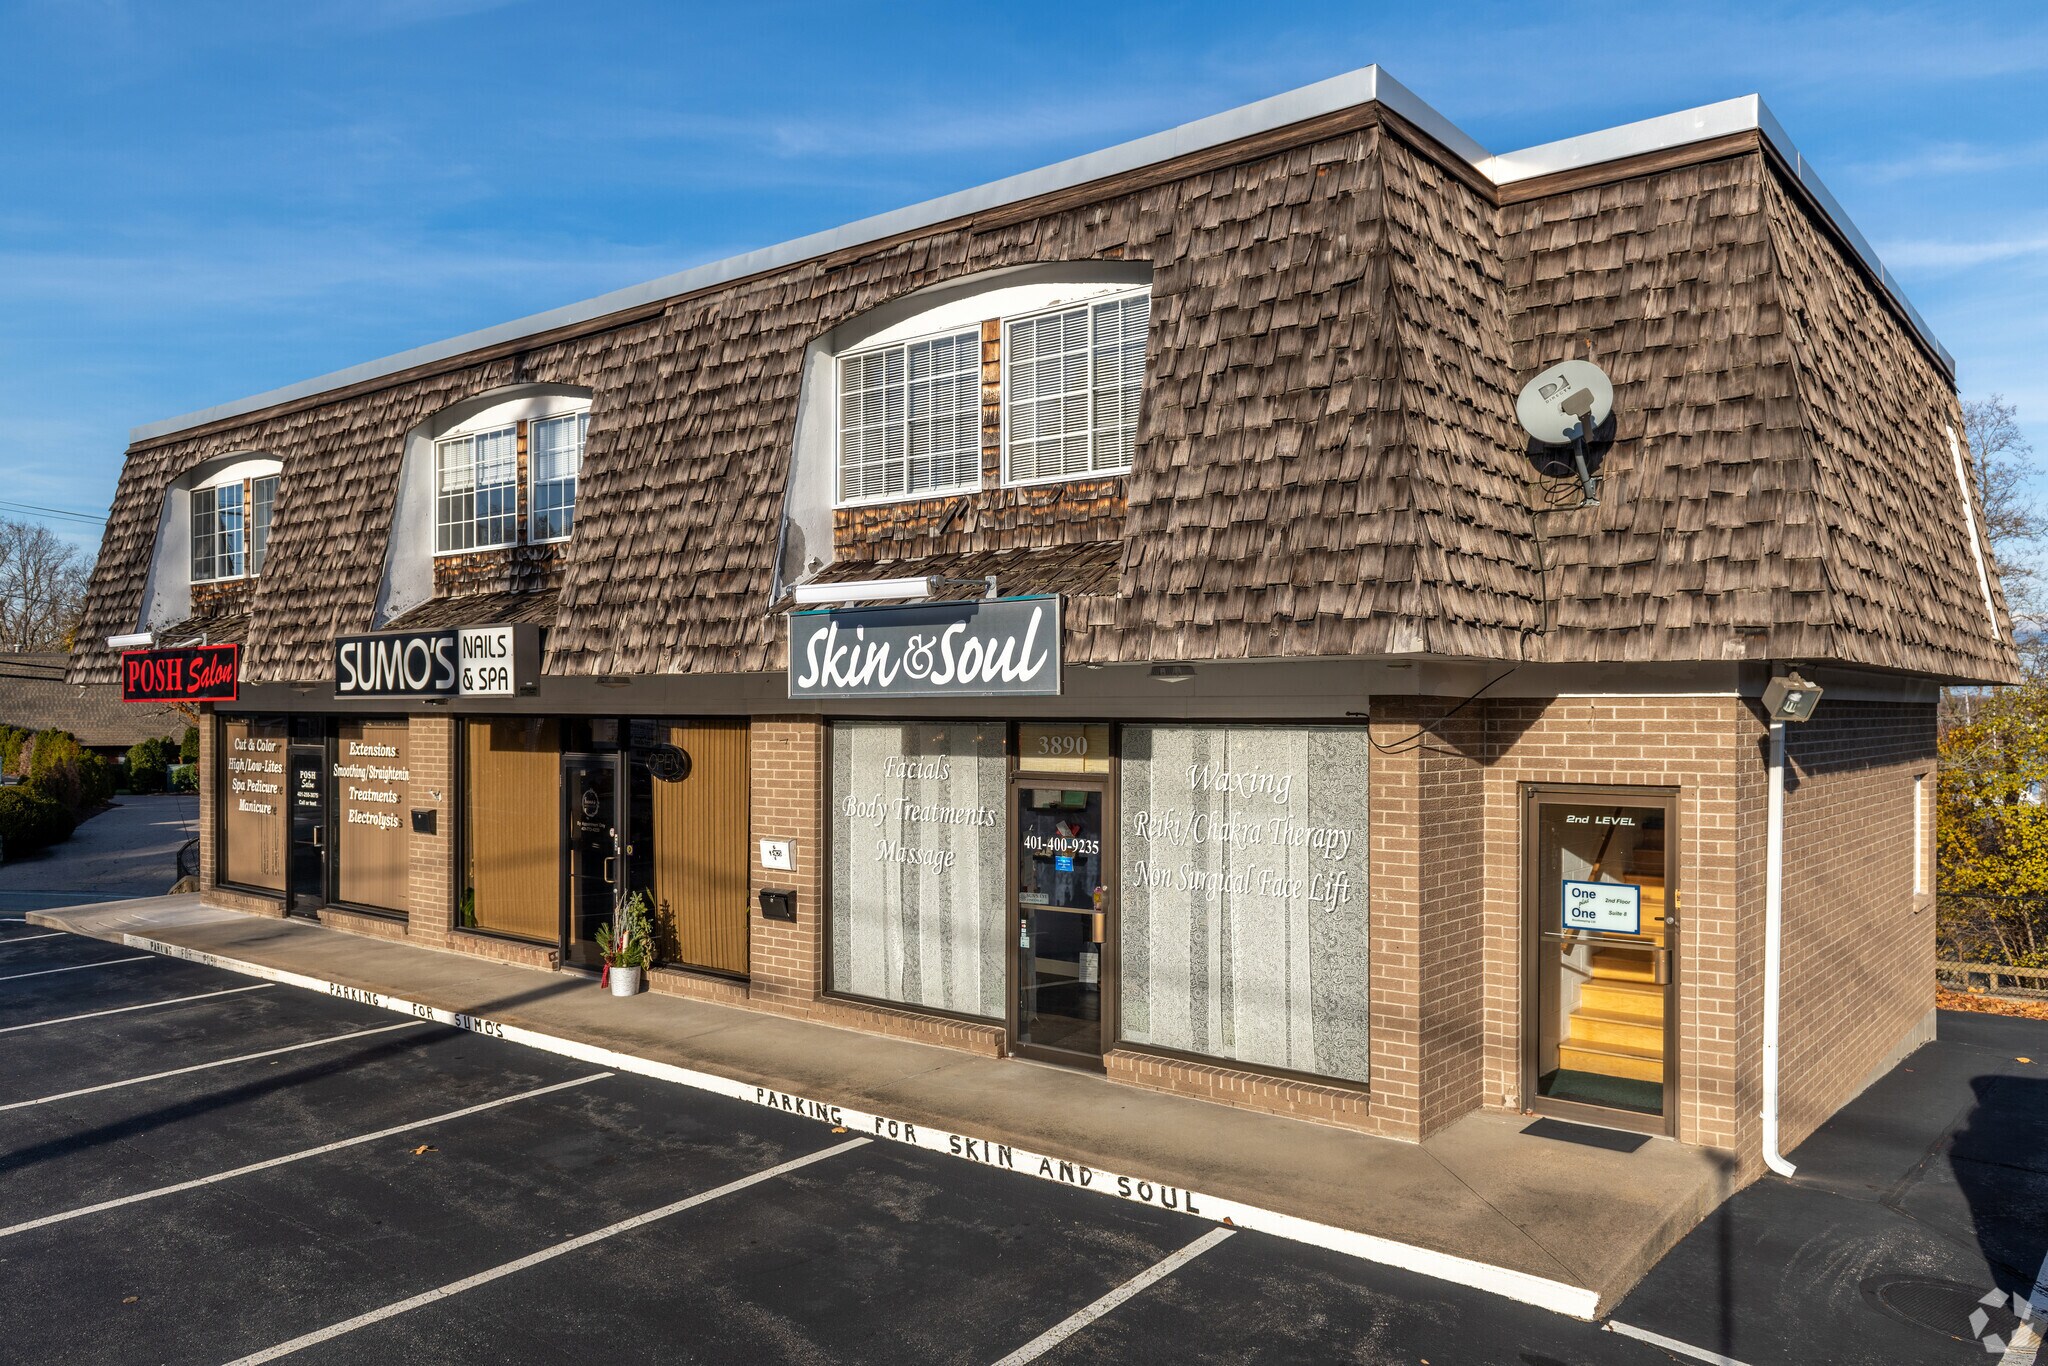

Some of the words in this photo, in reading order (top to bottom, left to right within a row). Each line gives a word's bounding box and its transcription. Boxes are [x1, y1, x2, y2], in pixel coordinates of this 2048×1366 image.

[463, 635, 506, 659] NAILS
[798, 620, 900, 688] Skin
[903, 633, 937, 680] &
[930, 606, 1048, 685] Soul
[127, 658, 183, 693] POSH
[187, 653, 233, 694] Salon
[340, 637, 456, 691] SUMO'S
[463, 668, 474, 690] &
[479, 667, 508, 691] SPA
[234, 738, 247, 751] Cut
[247, 738, 256, 751] &
[256, 738, 277, 752] Color
[349, 742, 397, 757] Extensions
[1038, 735, 1088, 756] 3890
[228, 757, 283, 774] High/Low-Lites
[649, 753, 680, 771] OPEN
[883, 754, 950, 780] Facials
[300, 770, 316, 779] POSH
[333, 763, 411, 784] Smoothing/Straightenin
[1185, 761, 1292, 805] Waxing
[232, 778, 246, 794] Spa
[247, 779, 278, 794] Pedicure
[348, 786, 398, 803] Treatments
[239, 798, 272, 814] Manicure
[842, 793, 888, 827] Body
[891, 796, 997, 828] Treatments
[347, 809, 399, 830] Electrolysis
[1566, 815, 1590, 824] 2nd
[1595, 815, 1636, 826] LEVEL
[1024, 835, 1100, 855] 401-400-9235
[1133, 808, 1262, 850] Reiki/Chakra
[1267, 814, 1352, 861] Therapy
[875, 839, 956, 875] Massage
[1133, 860, 1172, 889] Non
[1176, 863, 1256, 902] Surgical
[1257, 868, 1302, 898] Face
[1307, 871, 1351, 913] Lift
[1571, 887, 1596, 899] One
[1571, 907, 1596, 919] One
[329, 982, 379, 1006] PARKING
[412, 1003, 434, 1020] FOR
[454, 1013, 504, 1038] SUMO'S
[756, 1087, 843, 1126] PARKING
[874, 1117, 917, 1144] FOR
[948, 1134, 1013, 1168] SKIN
[1038, 1156, 1093, 1187] AND
[1117, 1175, 1200, 1215] SOUL
